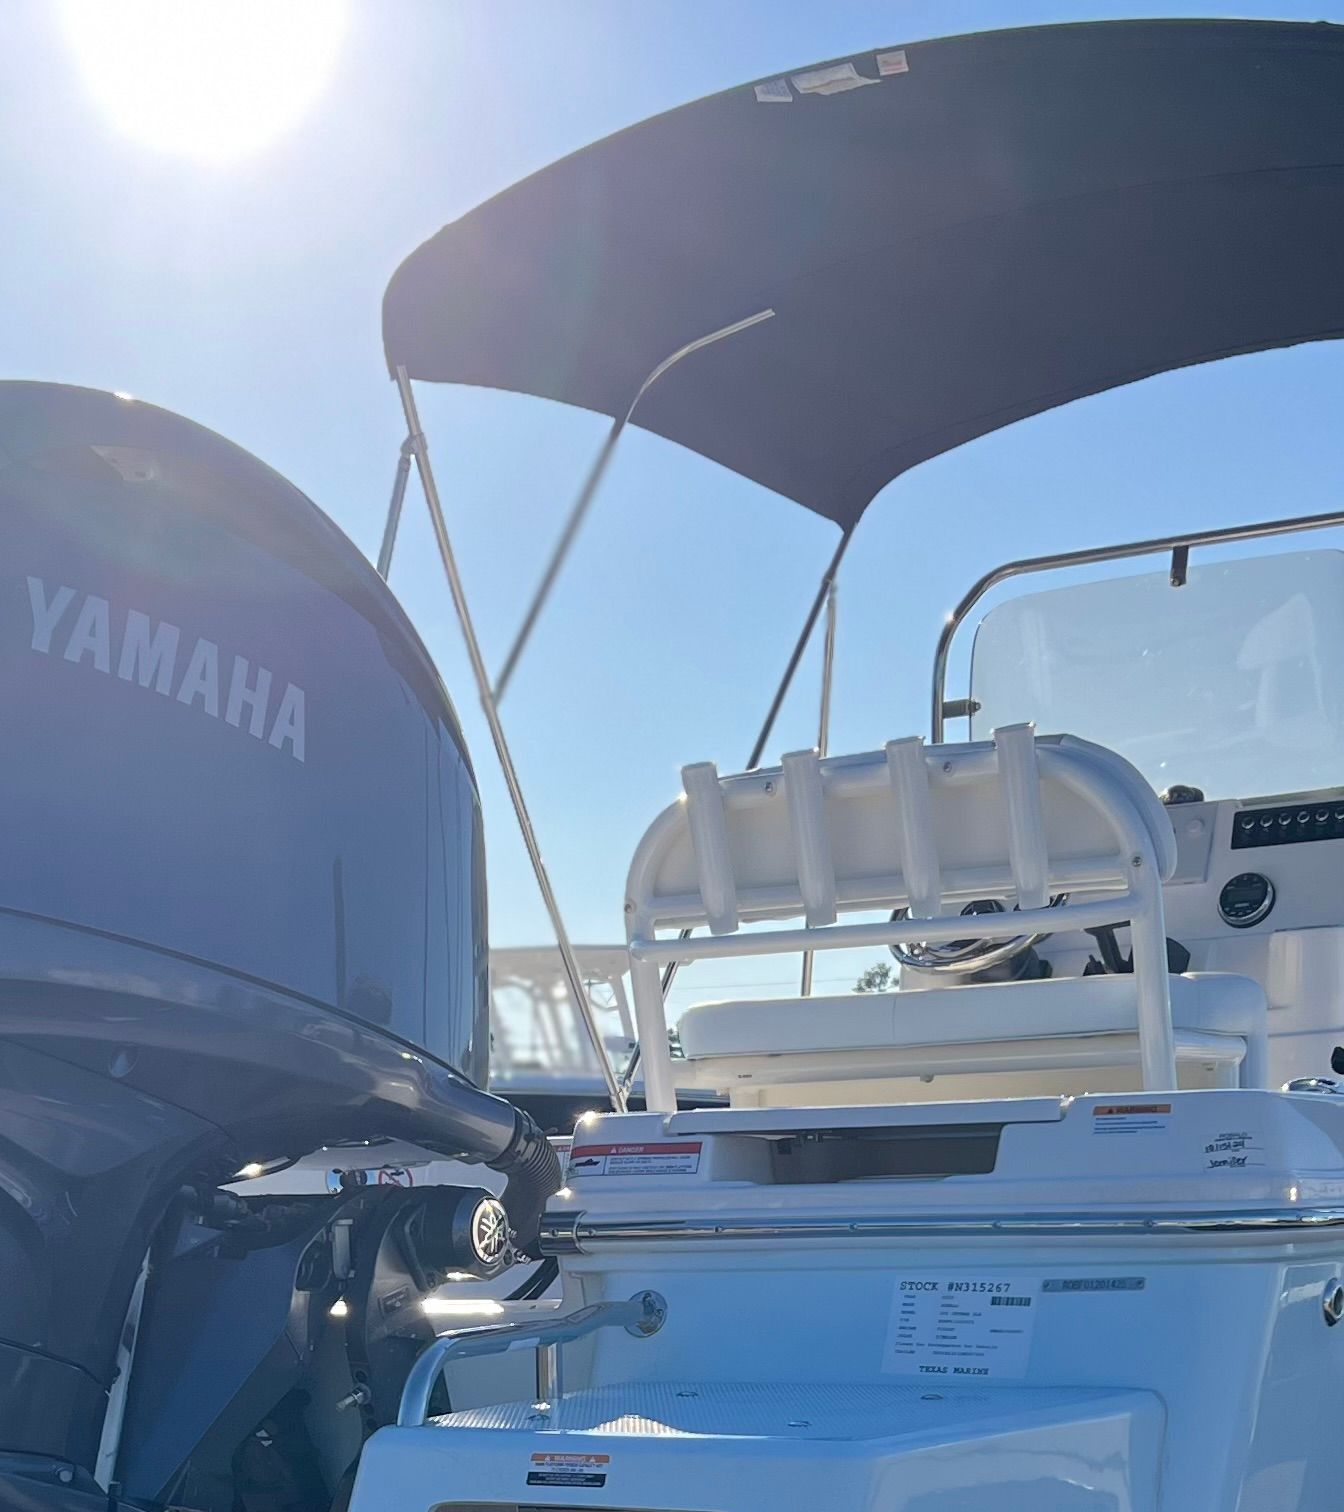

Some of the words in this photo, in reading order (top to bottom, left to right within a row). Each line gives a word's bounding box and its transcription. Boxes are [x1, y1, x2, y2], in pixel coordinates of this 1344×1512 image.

[26, 575, 306, 763] YAMAHA
[899, 1281, 939, 1291] STOCK
[947, 1282, 1011, 1293] #N315267
[919, 1365, 948, 1374] TEXAS
[953, 1366, 990, 1376] MARINE
